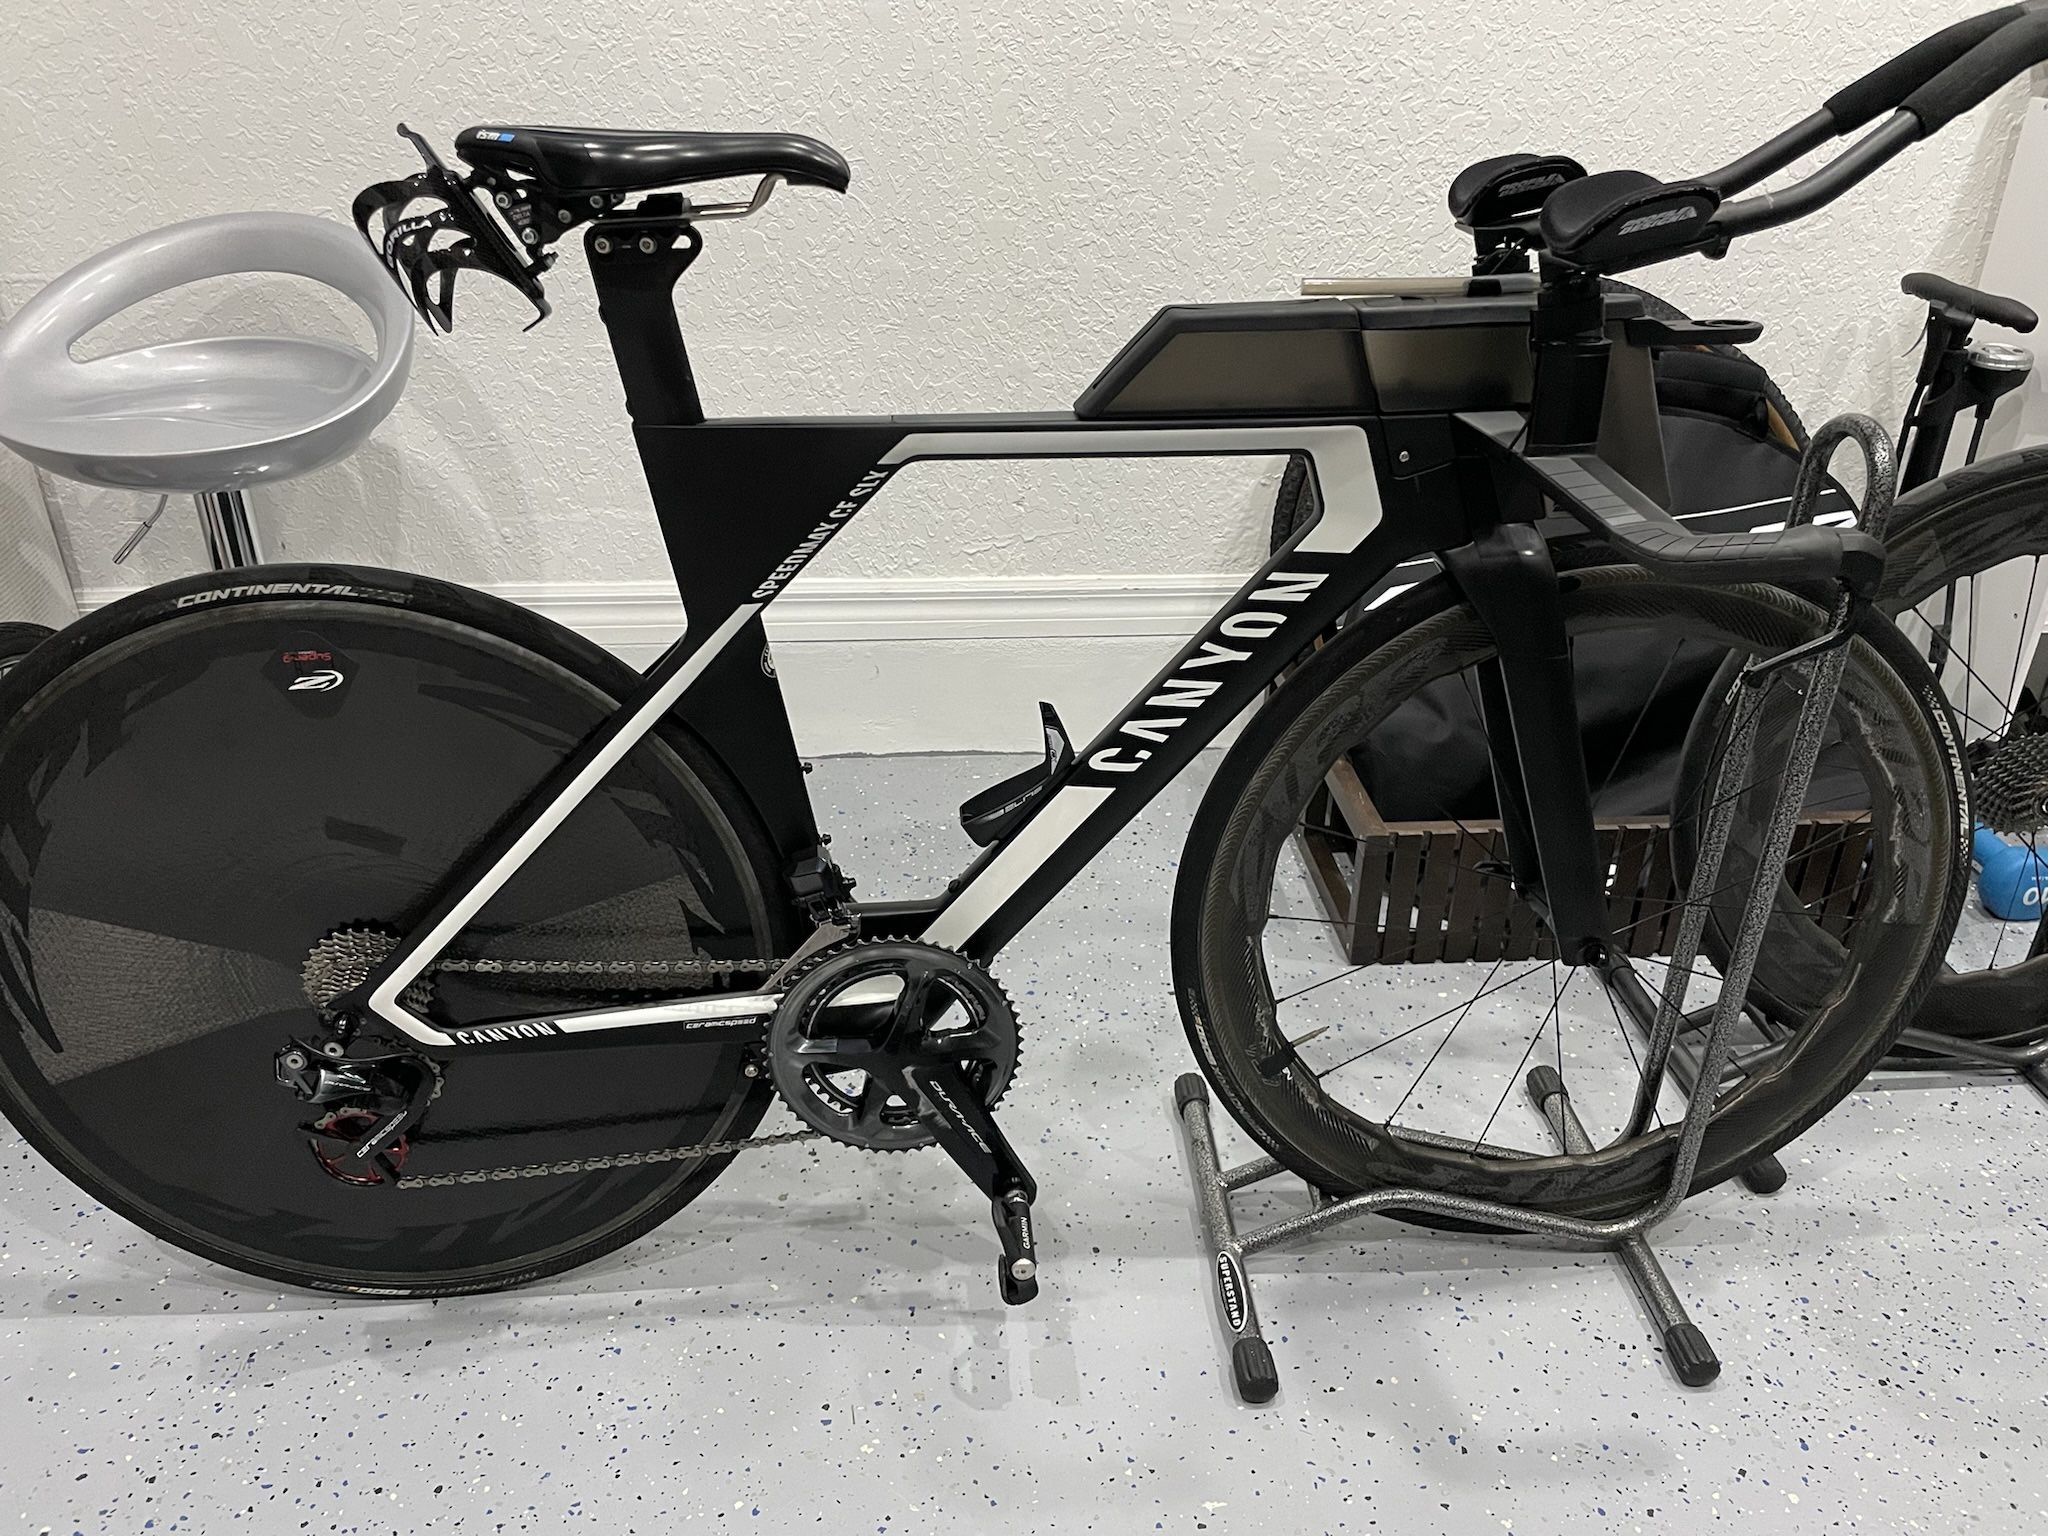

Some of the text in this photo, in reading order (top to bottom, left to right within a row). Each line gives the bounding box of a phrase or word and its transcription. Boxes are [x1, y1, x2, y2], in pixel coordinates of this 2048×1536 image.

[752, 522, 839, 599] SPEEDMAX
[829, 500, 857, 518] CF
[849, 470, 889, 498] SLX
[177, 583, 359, 608] CONTINENTAL
[1088, 572, 1330, 773] CANYON
[1933, 708, 1970, 837] CONTINENTAL
[456, 1022, 557, 1045] CANYON
[1022, 1216, 1031, 1249] GARMIN
[1219, 1256, 1241, 1327] SUPERSTAND
